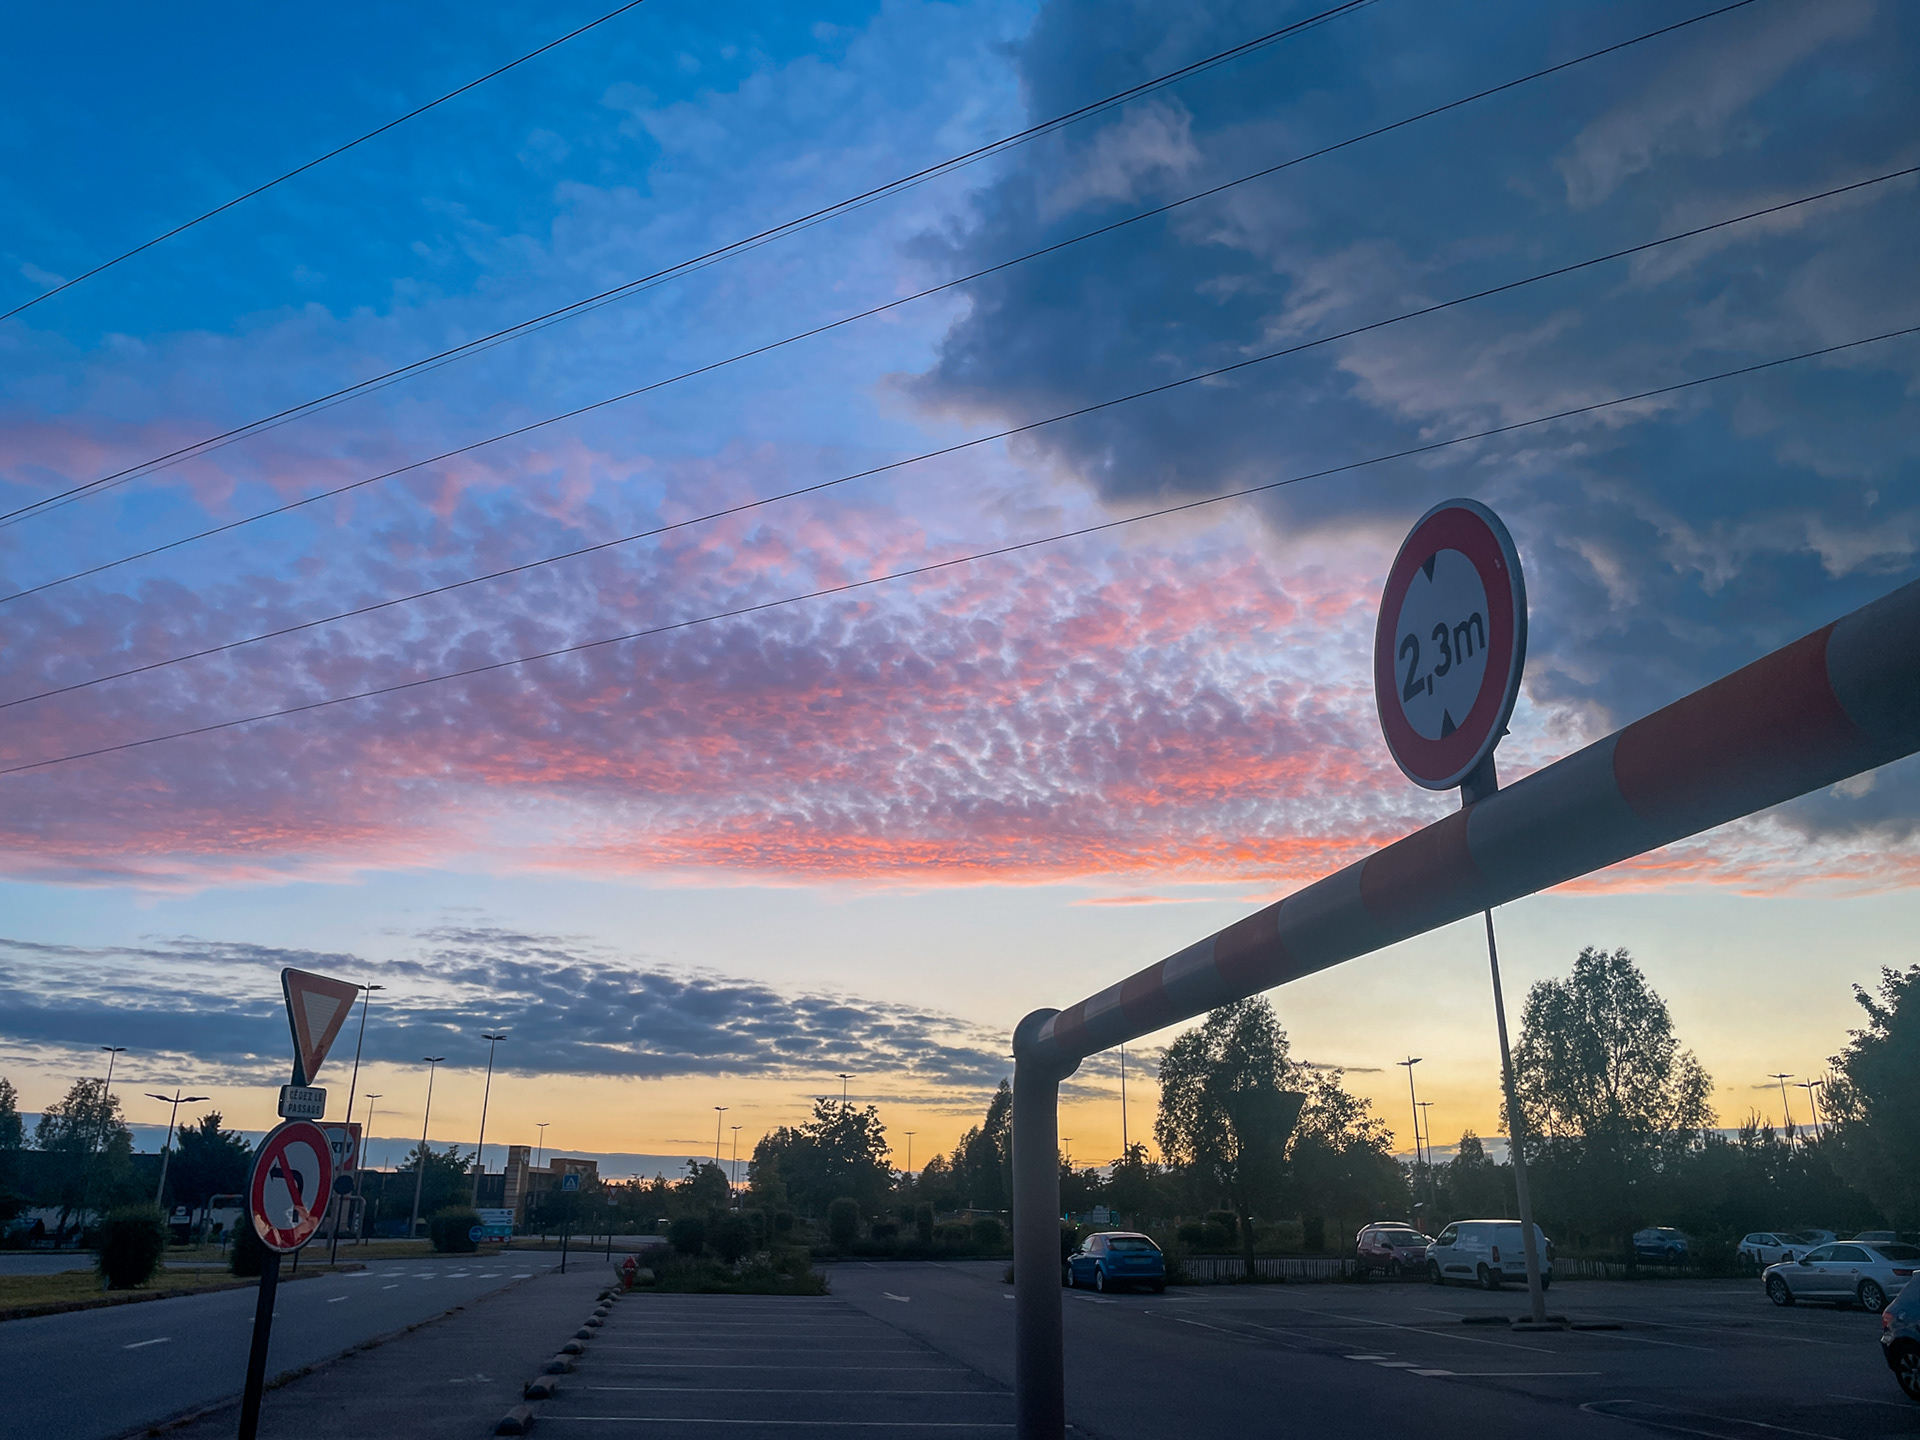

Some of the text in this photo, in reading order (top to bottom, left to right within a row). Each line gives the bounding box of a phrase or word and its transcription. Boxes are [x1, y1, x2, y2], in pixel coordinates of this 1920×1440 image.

[1399, 612, 1485, 702] 2,3m
[289, 1089, 322, 1102] CÉDEZ LE
[288, 1103, 321, 1115] PASSAGE
[331, 1141, 353, 1153] RTY
